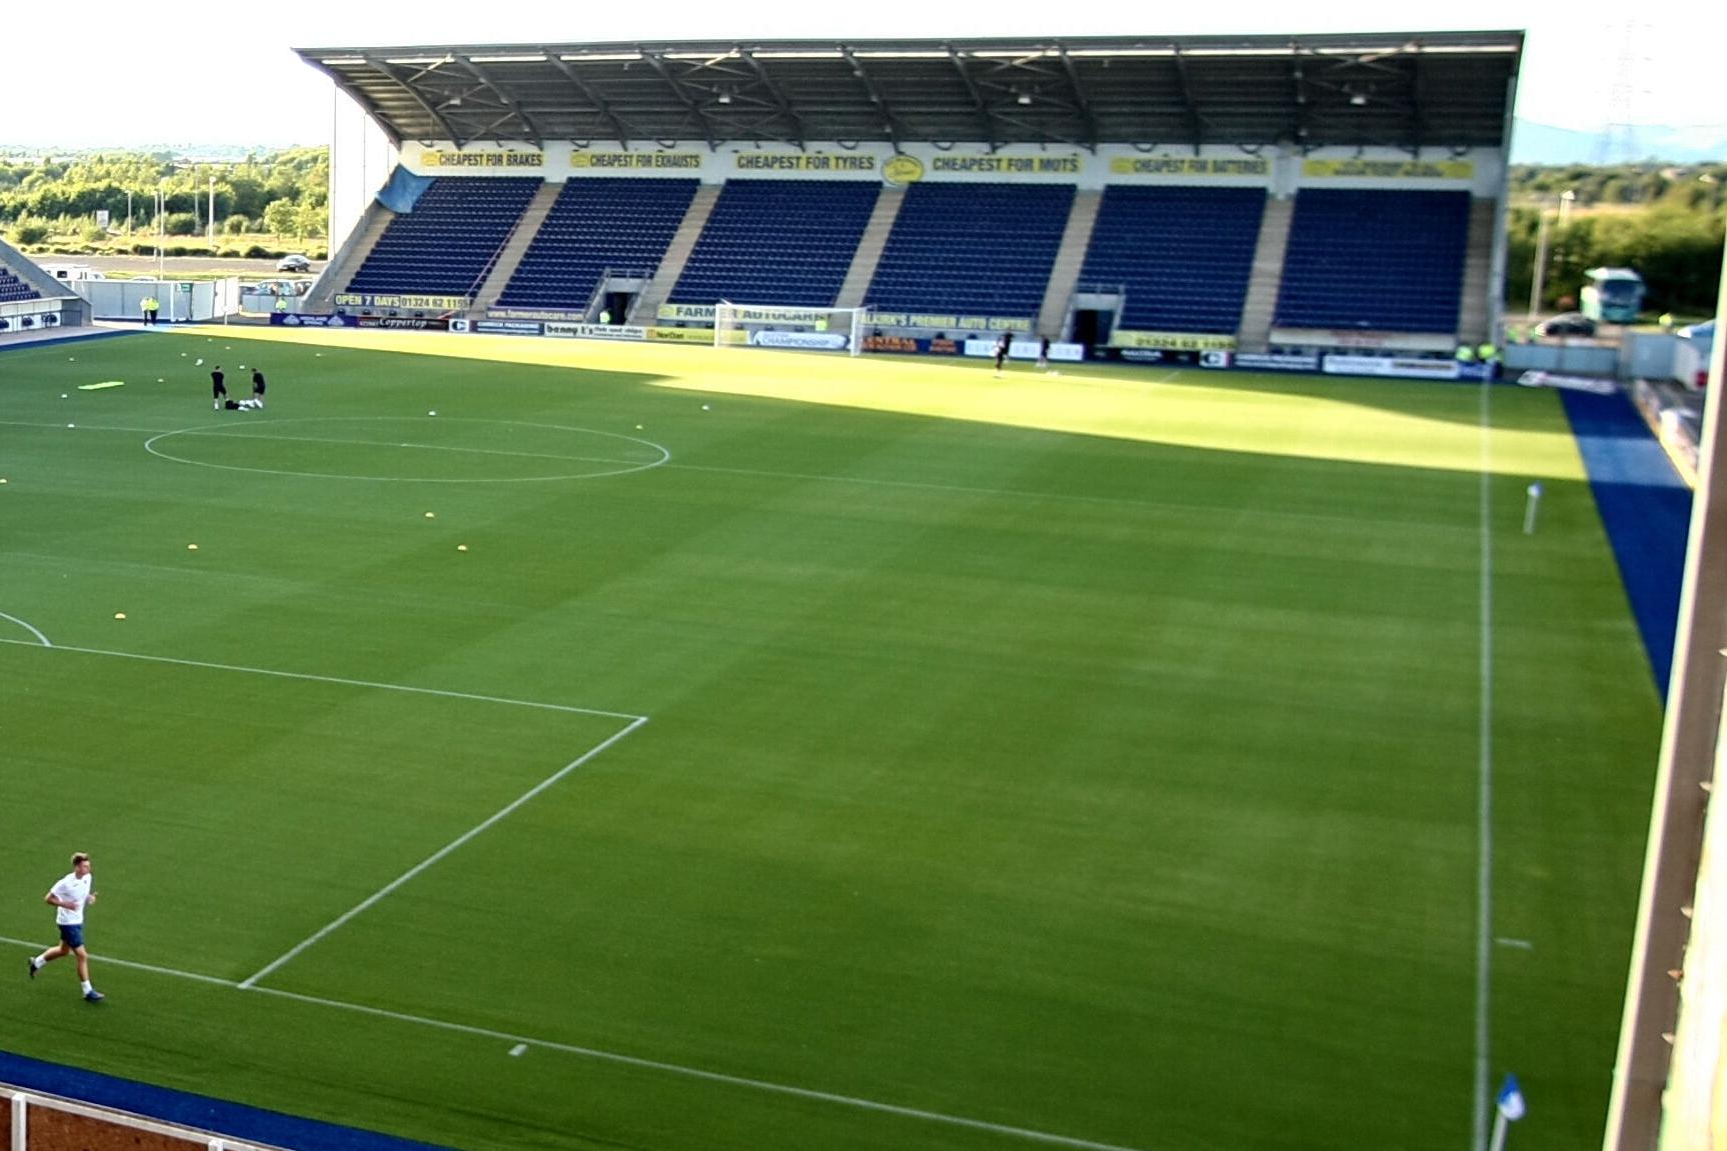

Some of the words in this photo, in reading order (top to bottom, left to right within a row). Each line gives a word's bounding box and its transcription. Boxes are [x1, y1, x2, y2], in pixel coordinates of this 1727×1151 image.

[439, 153, 484, 166] CHEAPEST
[486, 153, 504, 166] FOR
[506, 153, 543, 167] BRAKES
[590, 154, 634, 167] CHEAPEST
[636, 154, 652, 167] FOR
[655, 154, 700, 168] EXHAUSTS
[737, 155, 802, 169] CHEAPEST
[805, 156, 830, 169] FOR
[834, 156, 874, 170] TYRES
[932, 157, 1002, 171] CHEAPEST
[1007, 158, 1034, 172] FOR
[1135, 159, 1185, 173] CHEAPEST
[335, 294, 363, 305] OPEN
[365, 295, 371, 305] 7
[374, 295, 400, 306] DAYS
[400, 296, 430, 307] 01324
[676, 306, 737, 319] FARM
[379, 317, 427, 328] Coppertop
[958, 316, 987, 329] AUTO
[546, 324, 578, 336] benny
